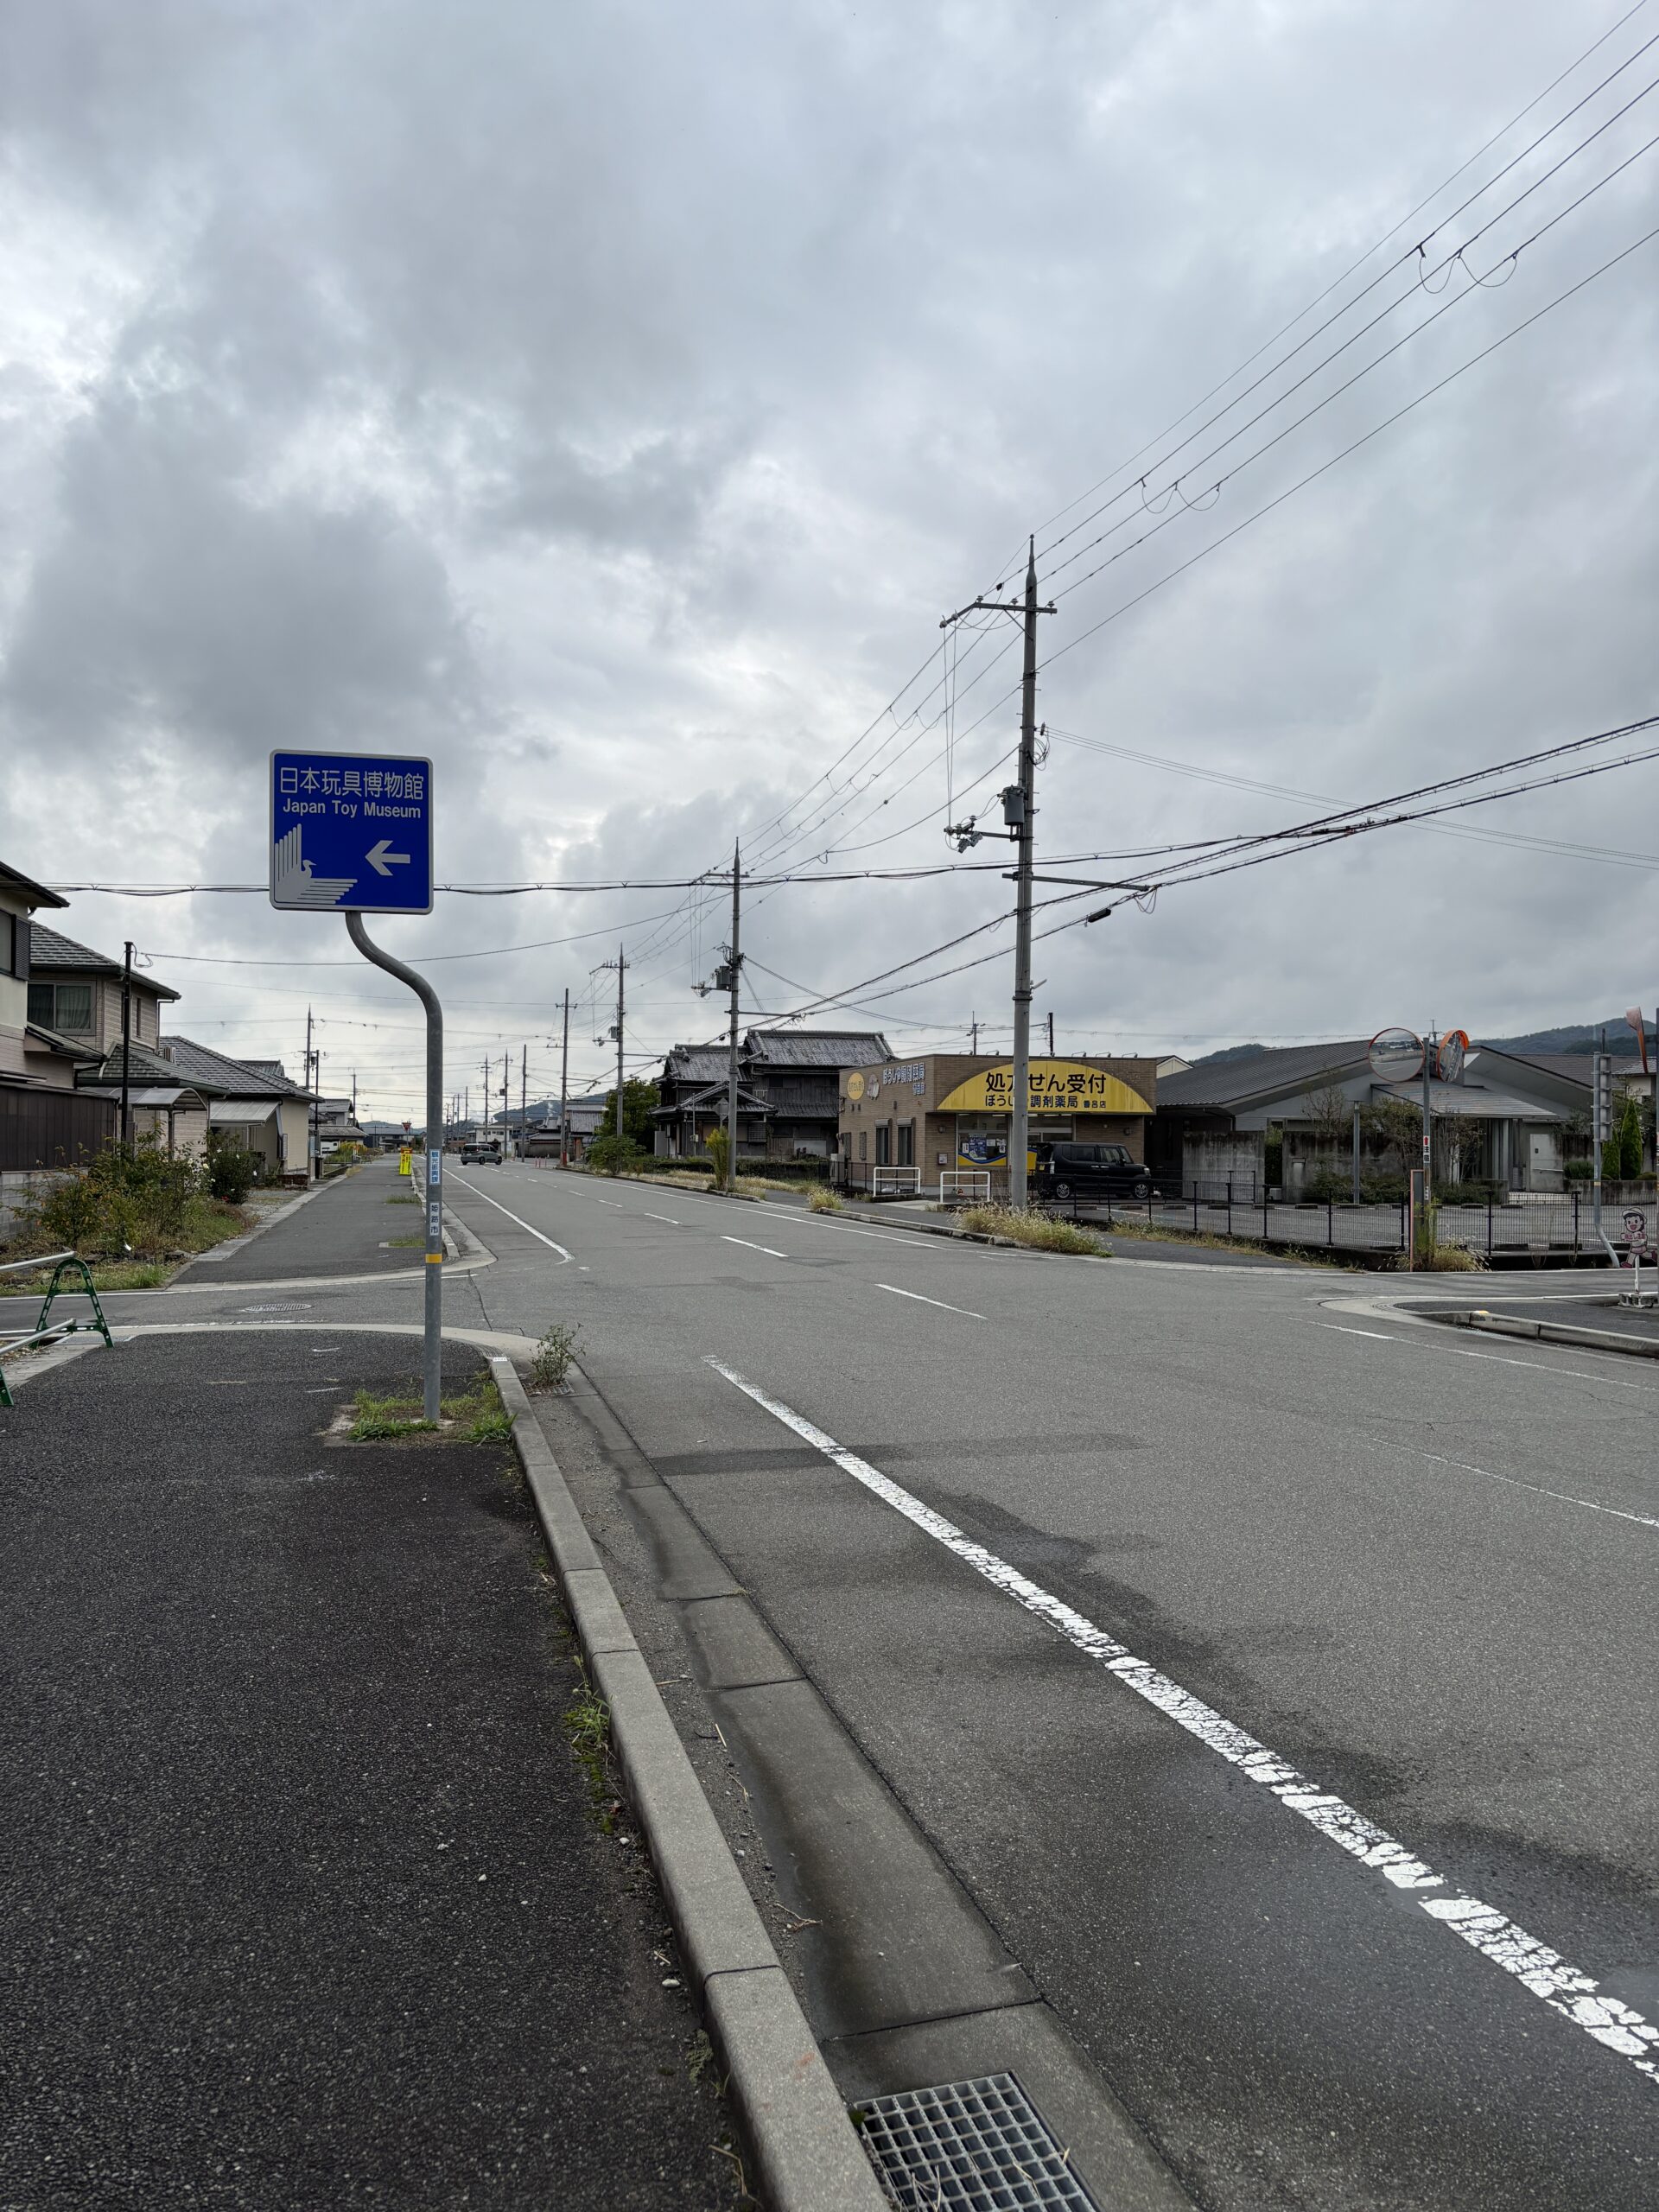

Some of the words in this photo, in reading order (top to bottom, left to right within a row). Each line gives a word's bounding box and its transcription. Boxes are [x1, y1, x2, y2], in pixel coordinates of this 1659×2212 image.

[280, 766, 424, 800] 日本玩具博物館
[283, 798, 326, 817] Japan
[332, 800, 358, 818] Toy
[364, 801, 421, 819] Museum
[985, 1094, 1078, 1109] ぼうし調剤薬局
